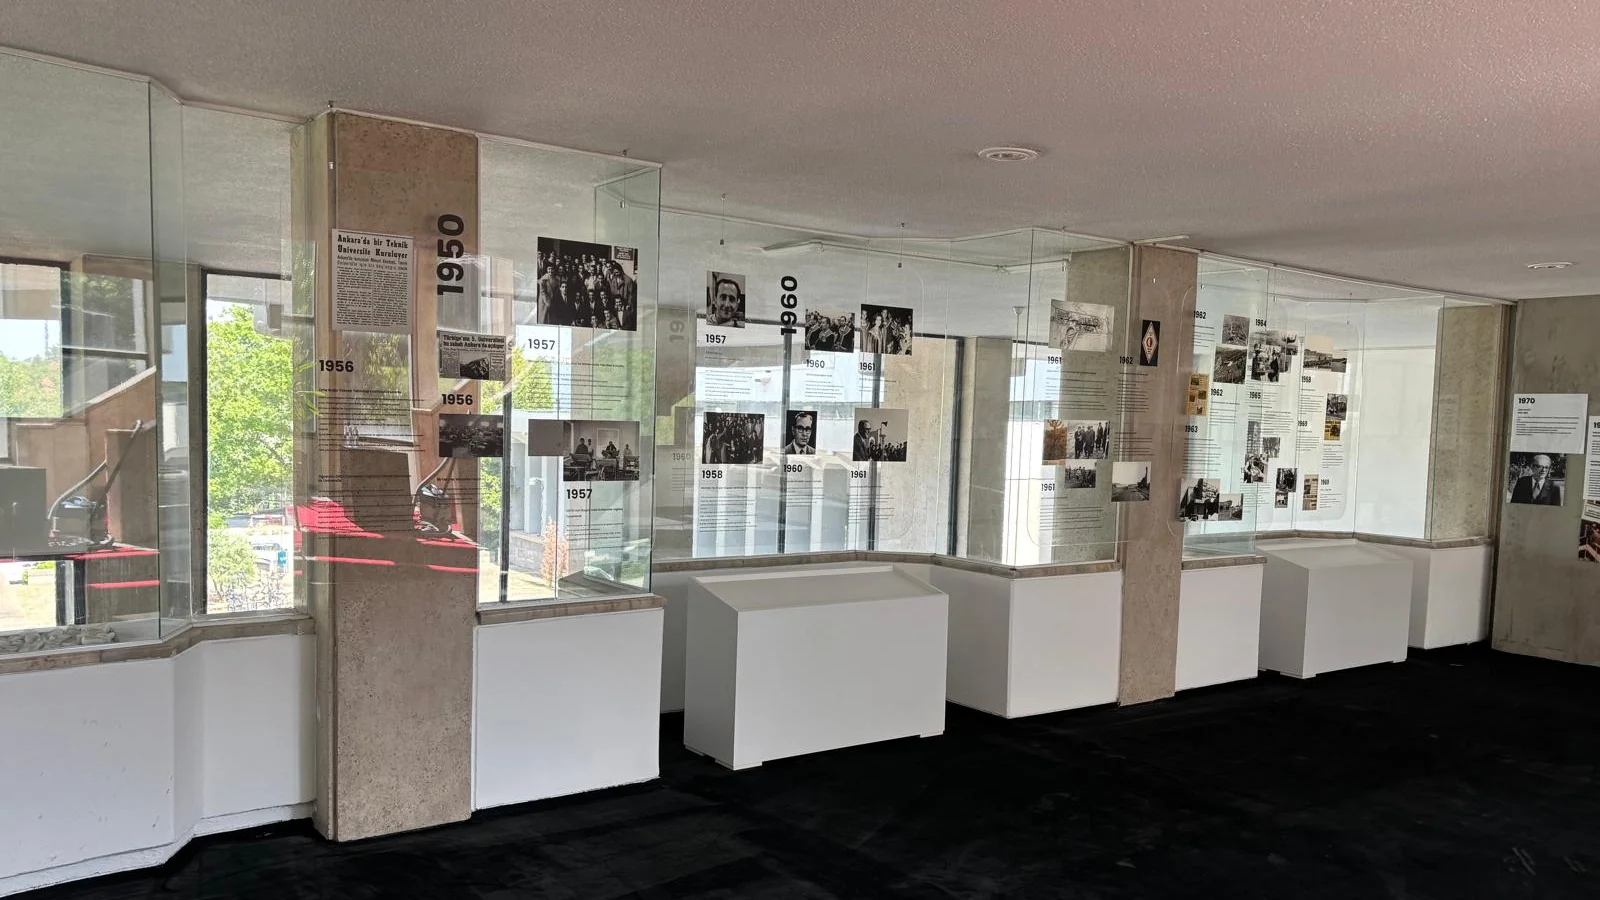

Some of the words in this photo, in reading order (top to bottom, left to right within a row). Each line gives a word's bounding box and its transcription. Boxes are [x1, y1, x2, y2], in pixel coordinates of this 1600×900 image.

[338, 234, 370, 245] Ankara'da
[373, 238, 384, 246] bir
[386, 239, 408, 249] Teknik
[437, 214, 464, 295] 1950
[781, 276, 798, 336] 1960
[1193, 310, 1207, 320] 1962
[528, 338, 556, 350] 1957
[706, 334, 727, 344] 1957
[806, 359, 825, 369] 1960
[1047, 356, 1062, 365] 1961
[1119, 356, 1134, 365] 1962
[319, 359, 354, 373] 1956
[860, 362, 876, 371] 1961
[1211, 388, 1223, 397] 1962
[441, 393, 473, 406] 1956
[1185, 425, 1198, 433] 1963
[783, 464, 803, 473] 1960
[702, 469, 723, 479] 1958
[850, 470, 867, 479] 1961
[1041, 483, 1055, 492] 1961
[566, 488, 593, 500] 1957
